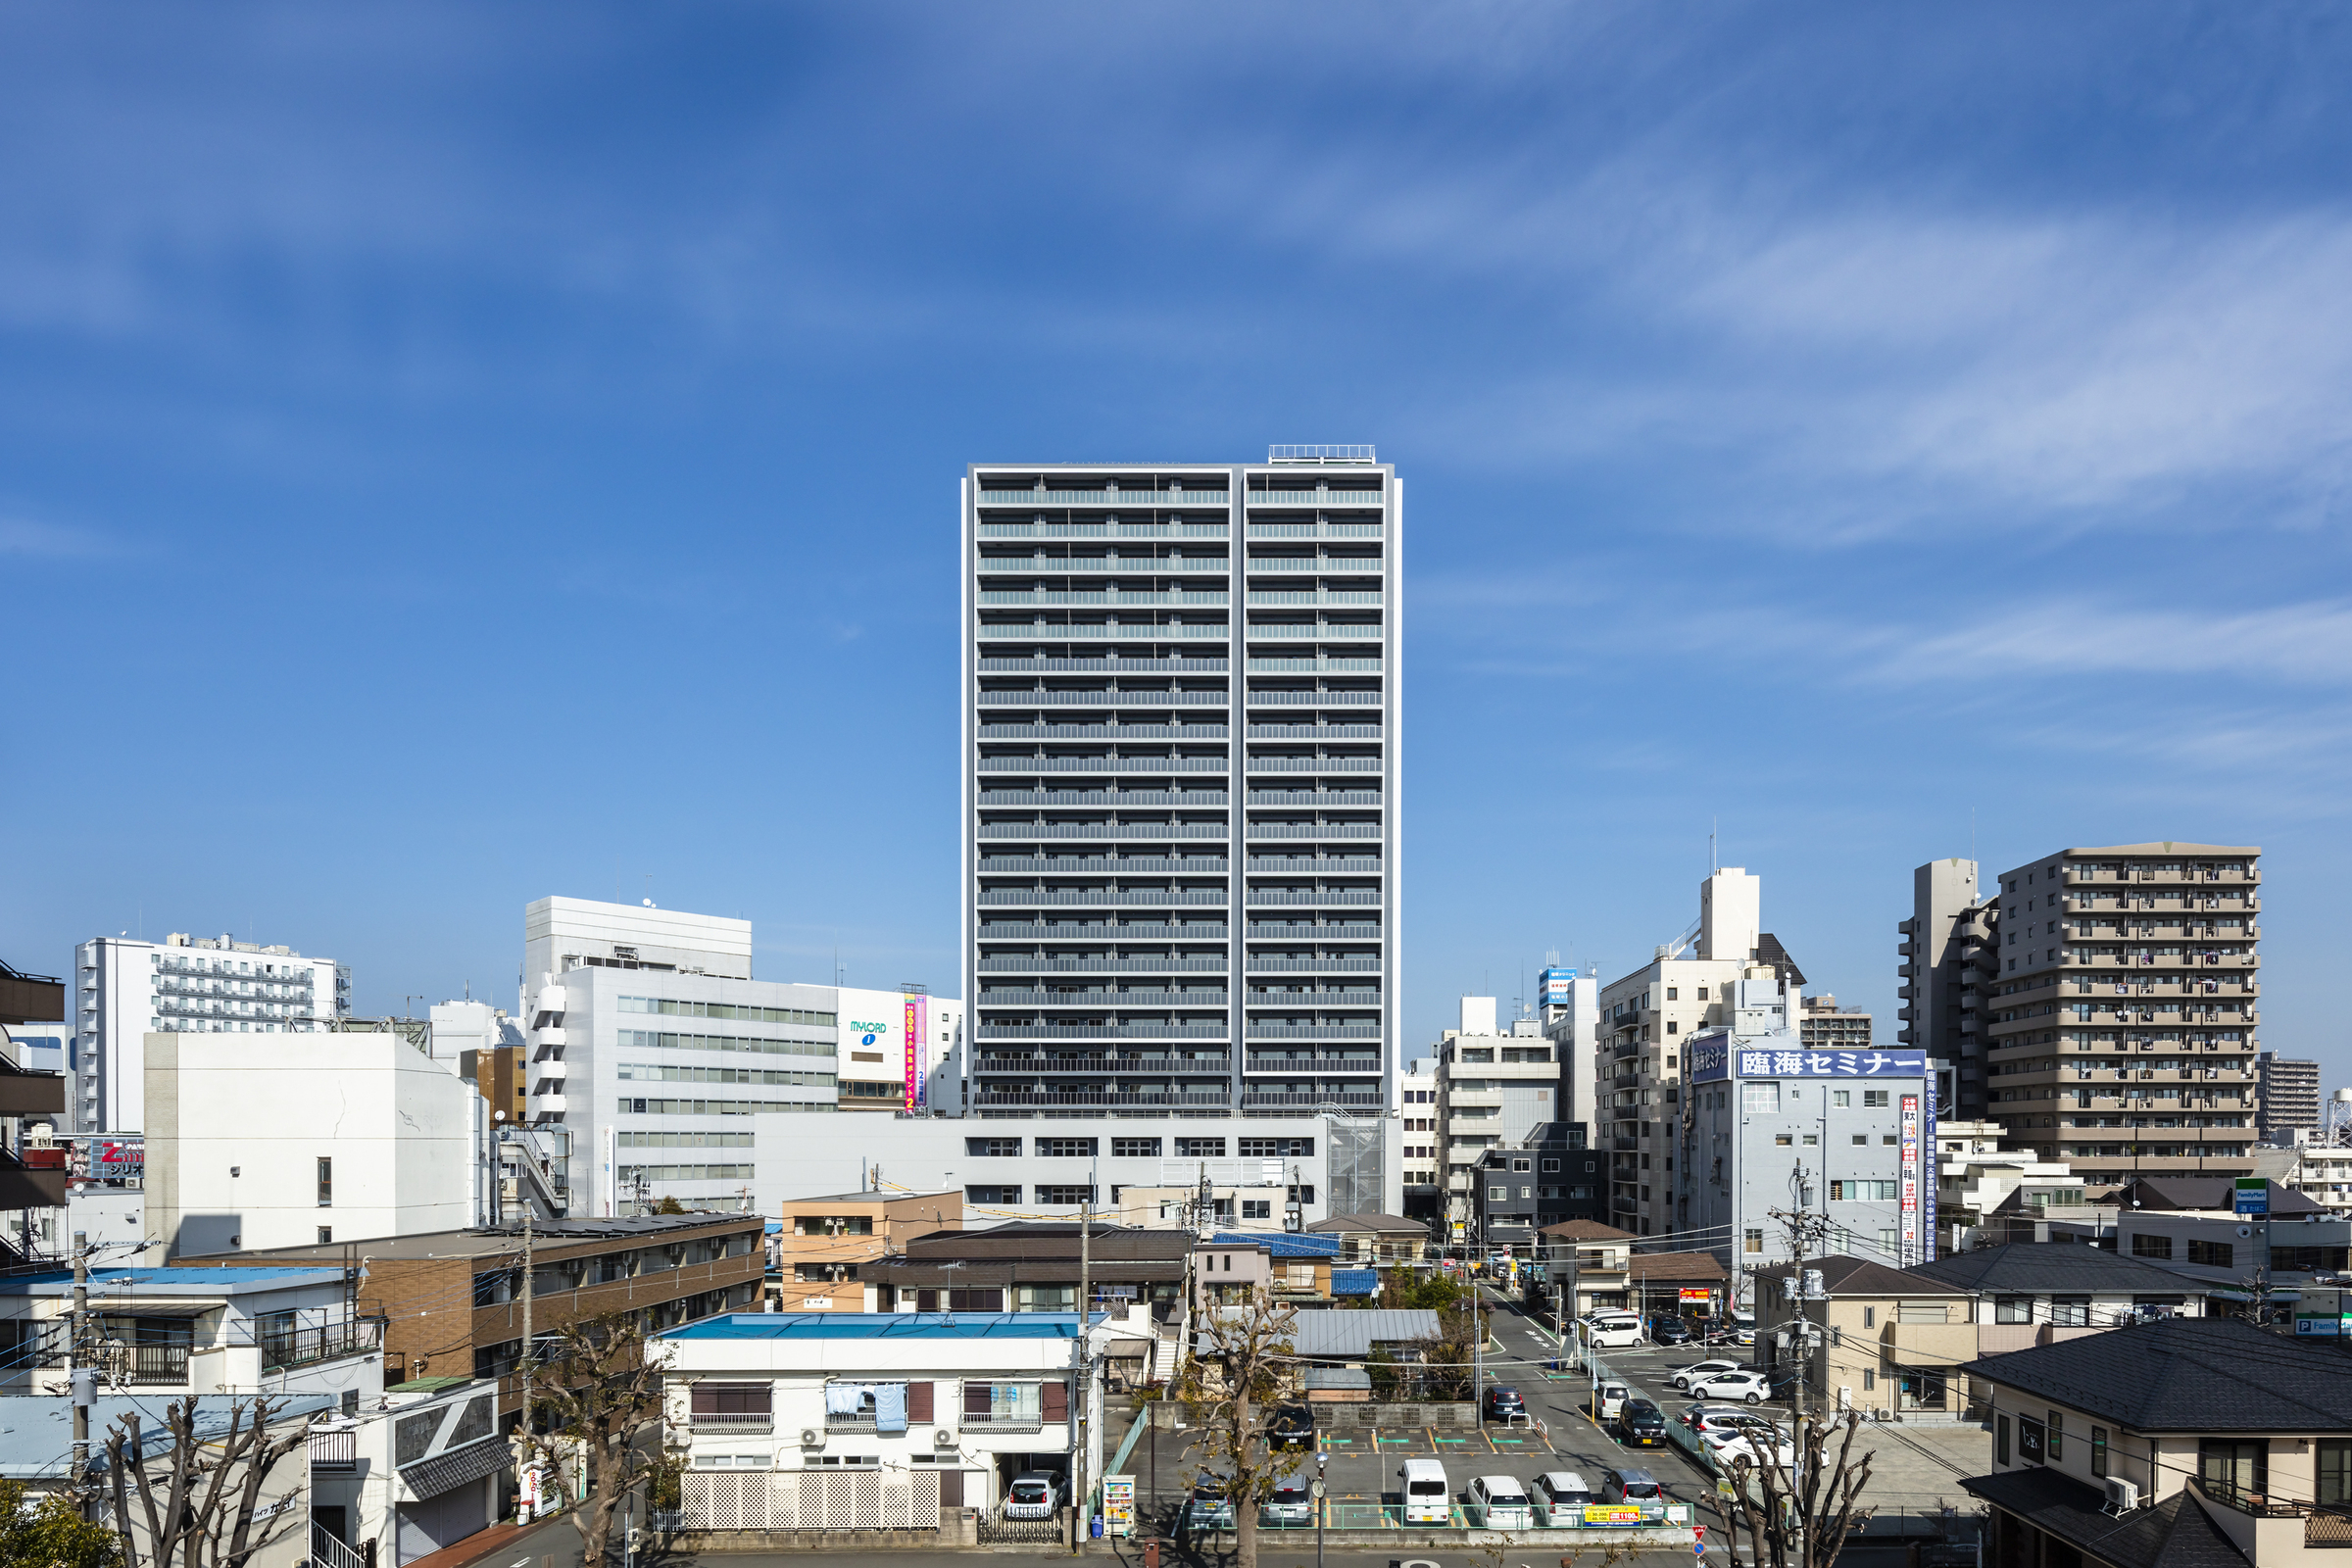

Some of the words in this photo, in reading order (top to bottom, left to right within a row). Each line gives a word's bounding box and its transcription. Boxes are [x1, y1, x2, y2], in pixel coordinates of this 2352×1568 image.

[851, 1020, 887, 1033] MYLORD
[1692, 1046, 1728, 1072] 臨海セミナー
[1741, 1052, 1923, 1075] 臨海セミナー
[1927, 1070, 1936, 1133] 臨海セミナー
